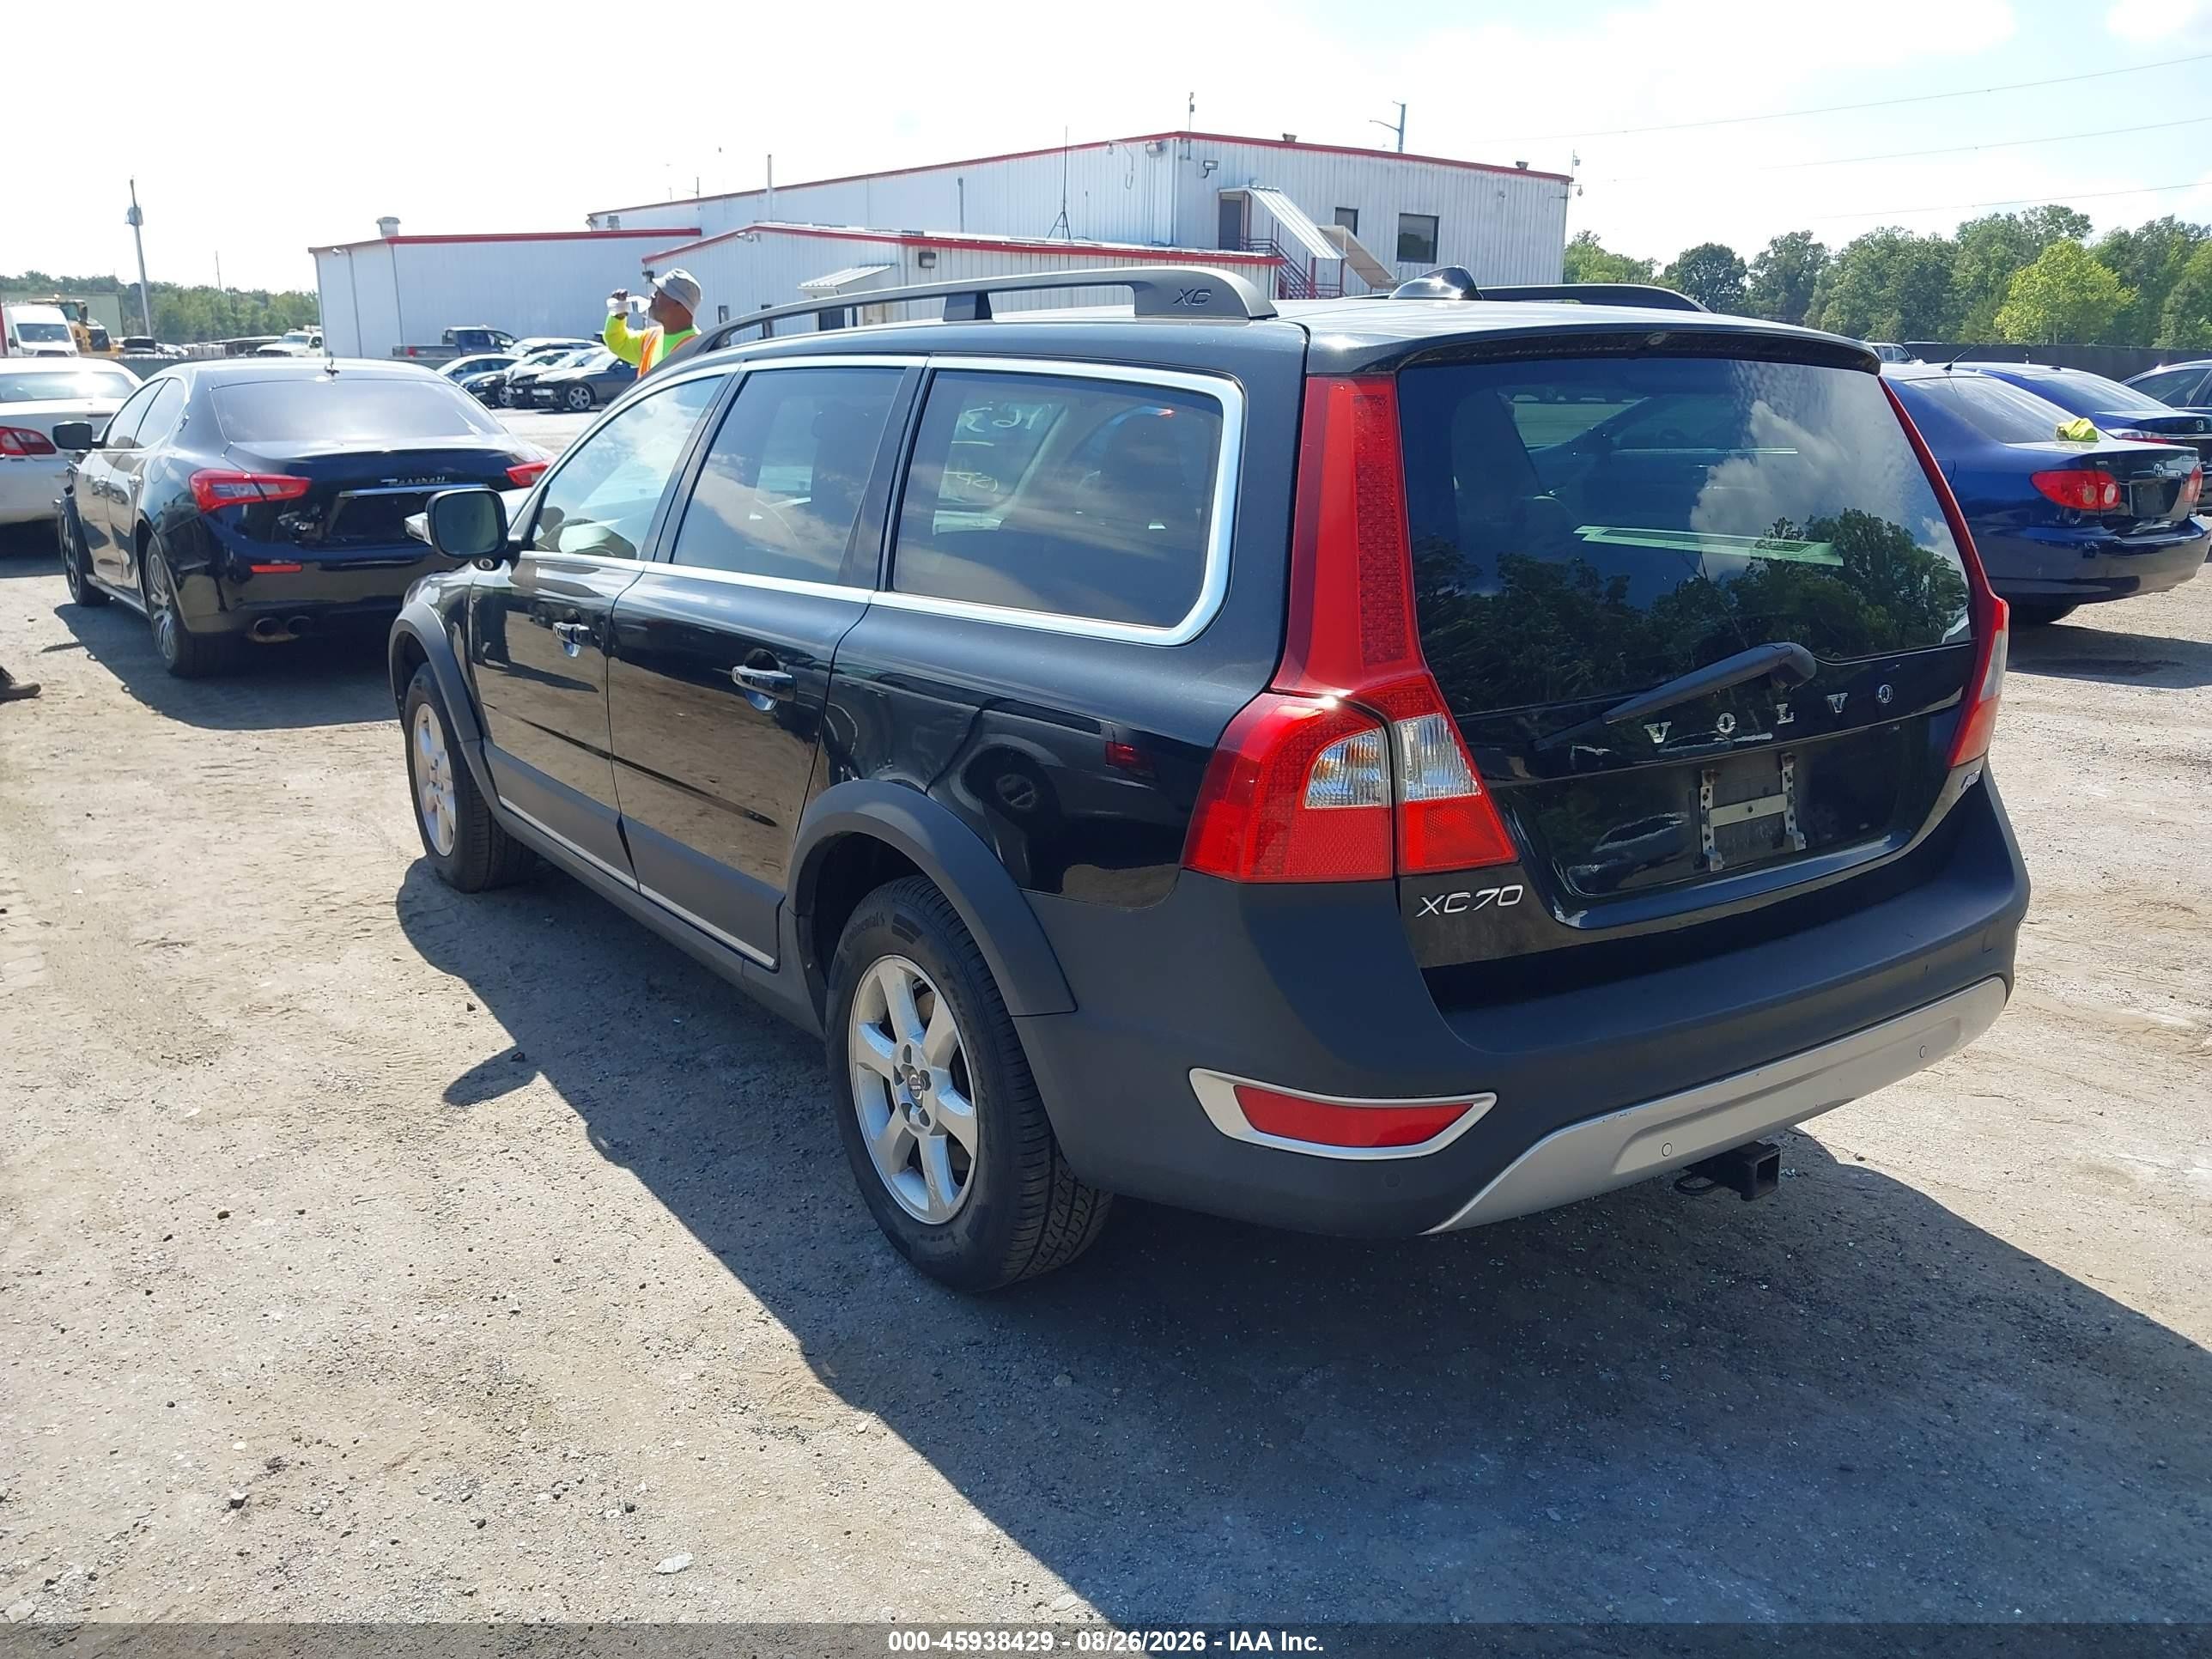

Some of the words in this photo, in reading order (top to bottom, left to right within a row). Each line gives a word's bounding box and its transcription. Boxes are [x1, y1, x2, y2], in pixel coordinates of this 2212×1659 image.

[1172, 288, 1212, 307] XC
[1644, 684, 1894, 744] VOLVO
[1416, 884, 1523, 917] XC70
